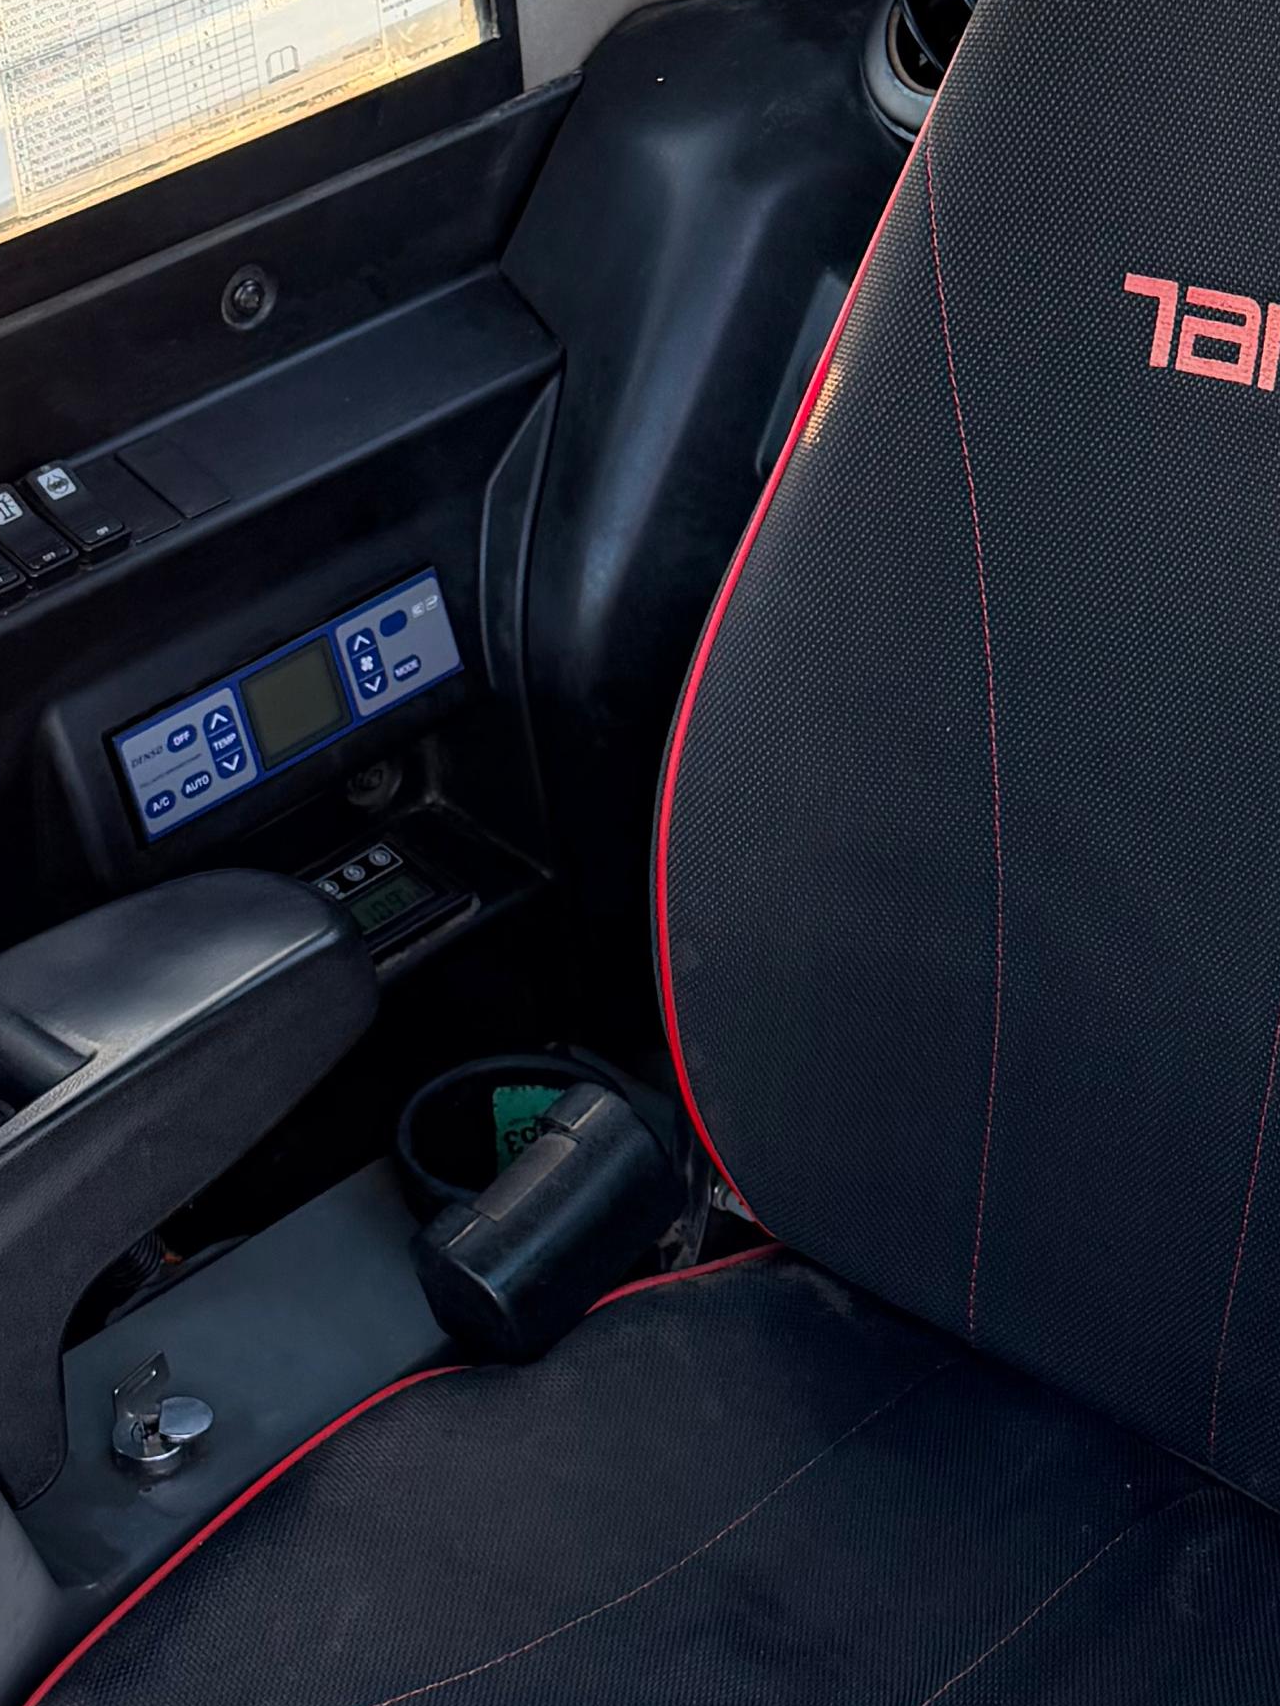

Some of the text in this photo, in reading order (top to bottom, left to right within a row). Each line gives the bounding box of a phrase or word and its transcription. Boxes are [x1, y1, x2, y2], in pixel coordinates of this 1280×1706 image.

[173, 730, 191, 746] OFF
[212, 732, 237, 751] TEMP
[152, 774, 209, 812] A/C AUTO
